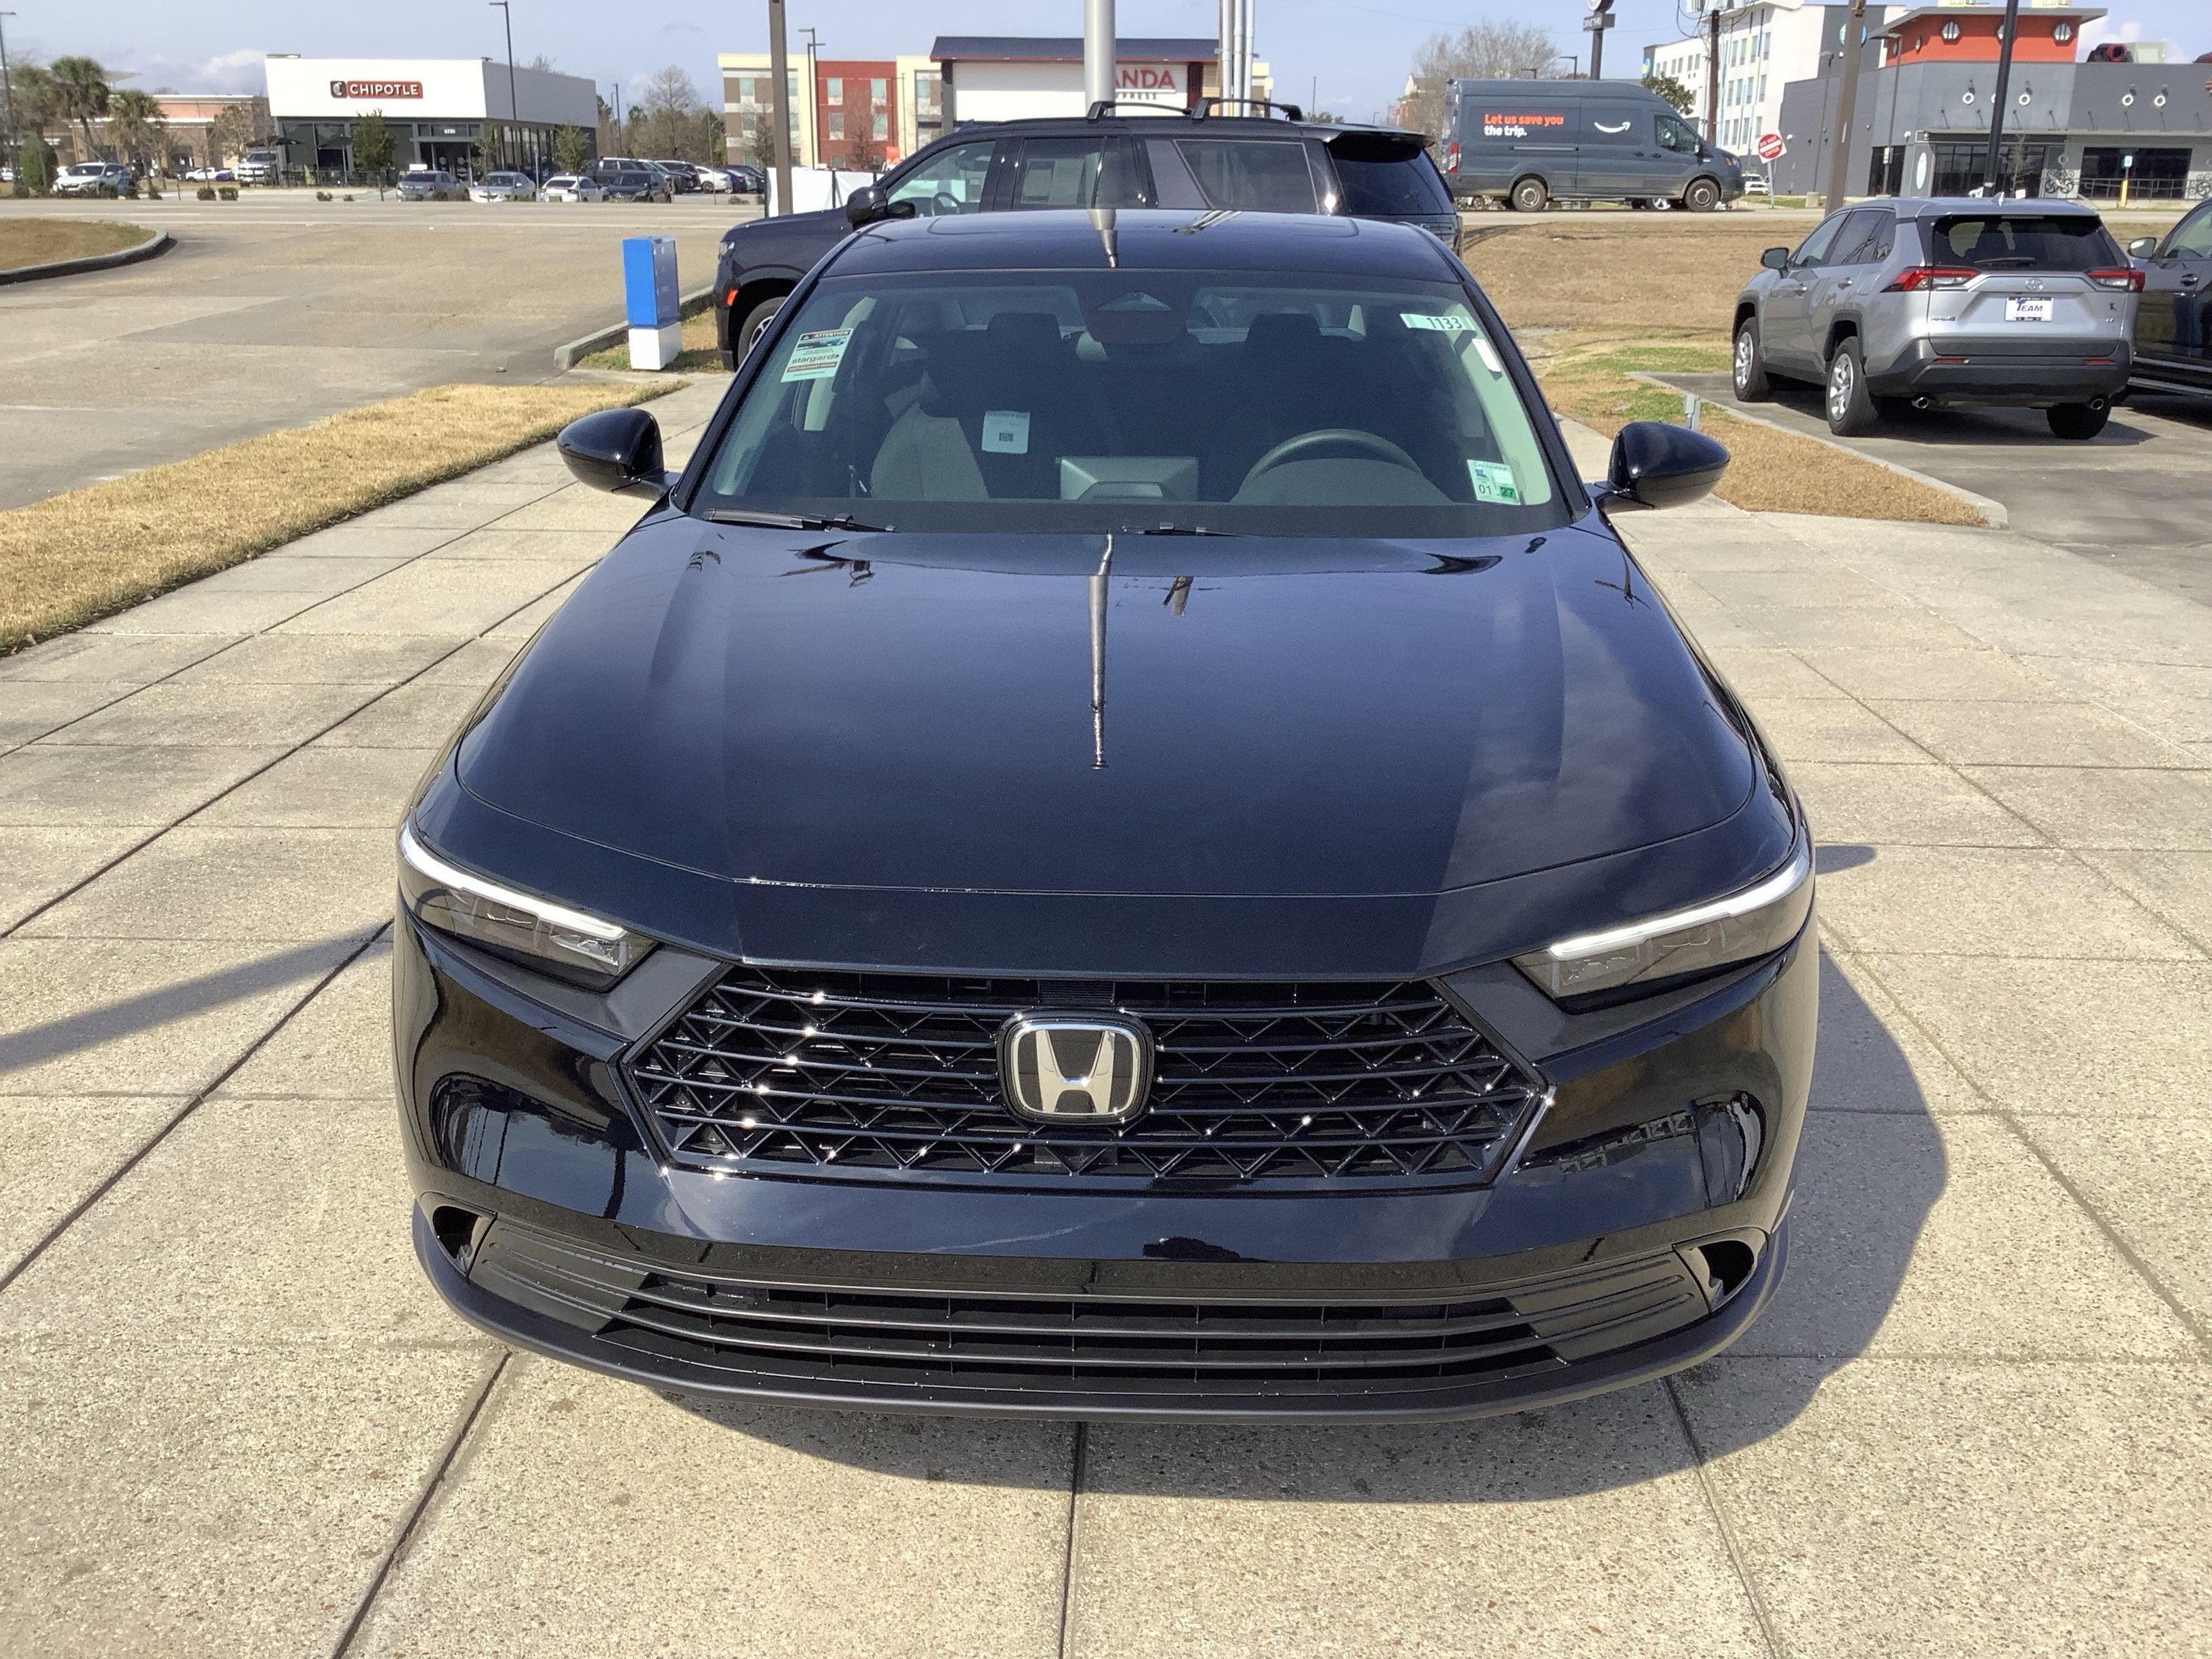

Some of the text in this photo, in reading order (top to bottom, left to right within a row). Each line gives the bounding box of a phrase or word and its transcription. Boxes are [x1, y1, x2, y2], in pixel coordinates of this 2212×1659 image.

[1115, 69, 1176, 89] NDA
[350, 84, 418, 95] CHIPOTLE
[1485, 114, 1564, 127] Let us save you
[1484, 125, 1528, 138] the trip.
[2016, 298, 2043, 312] TEAM
[1427, 317, 1462, 329] 1133
[814, 330, 849, 338] ATTENTION
[1479, 484, 1514, 497] 01 27
